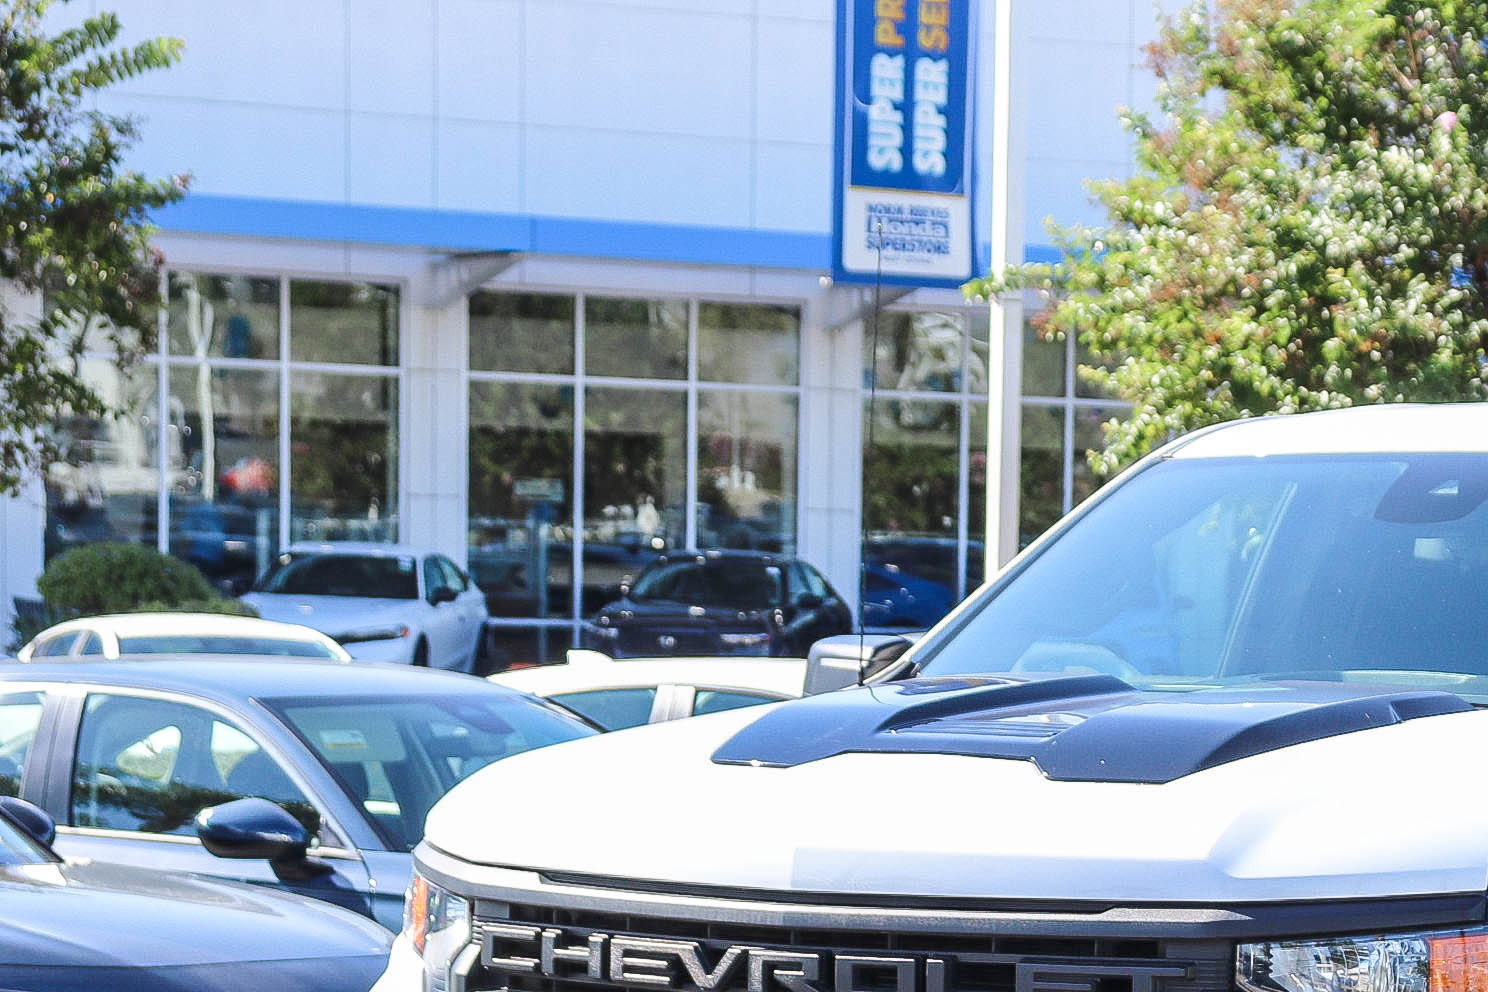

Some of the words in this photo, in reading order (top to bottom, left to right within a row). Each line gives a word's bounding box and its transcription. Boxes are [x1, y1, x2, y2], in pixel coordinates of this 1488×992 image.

[918, 0, 948, 52] SE
[867, 53, 905, 173] SUPER
[911, 56, 949, 177] SUPER
